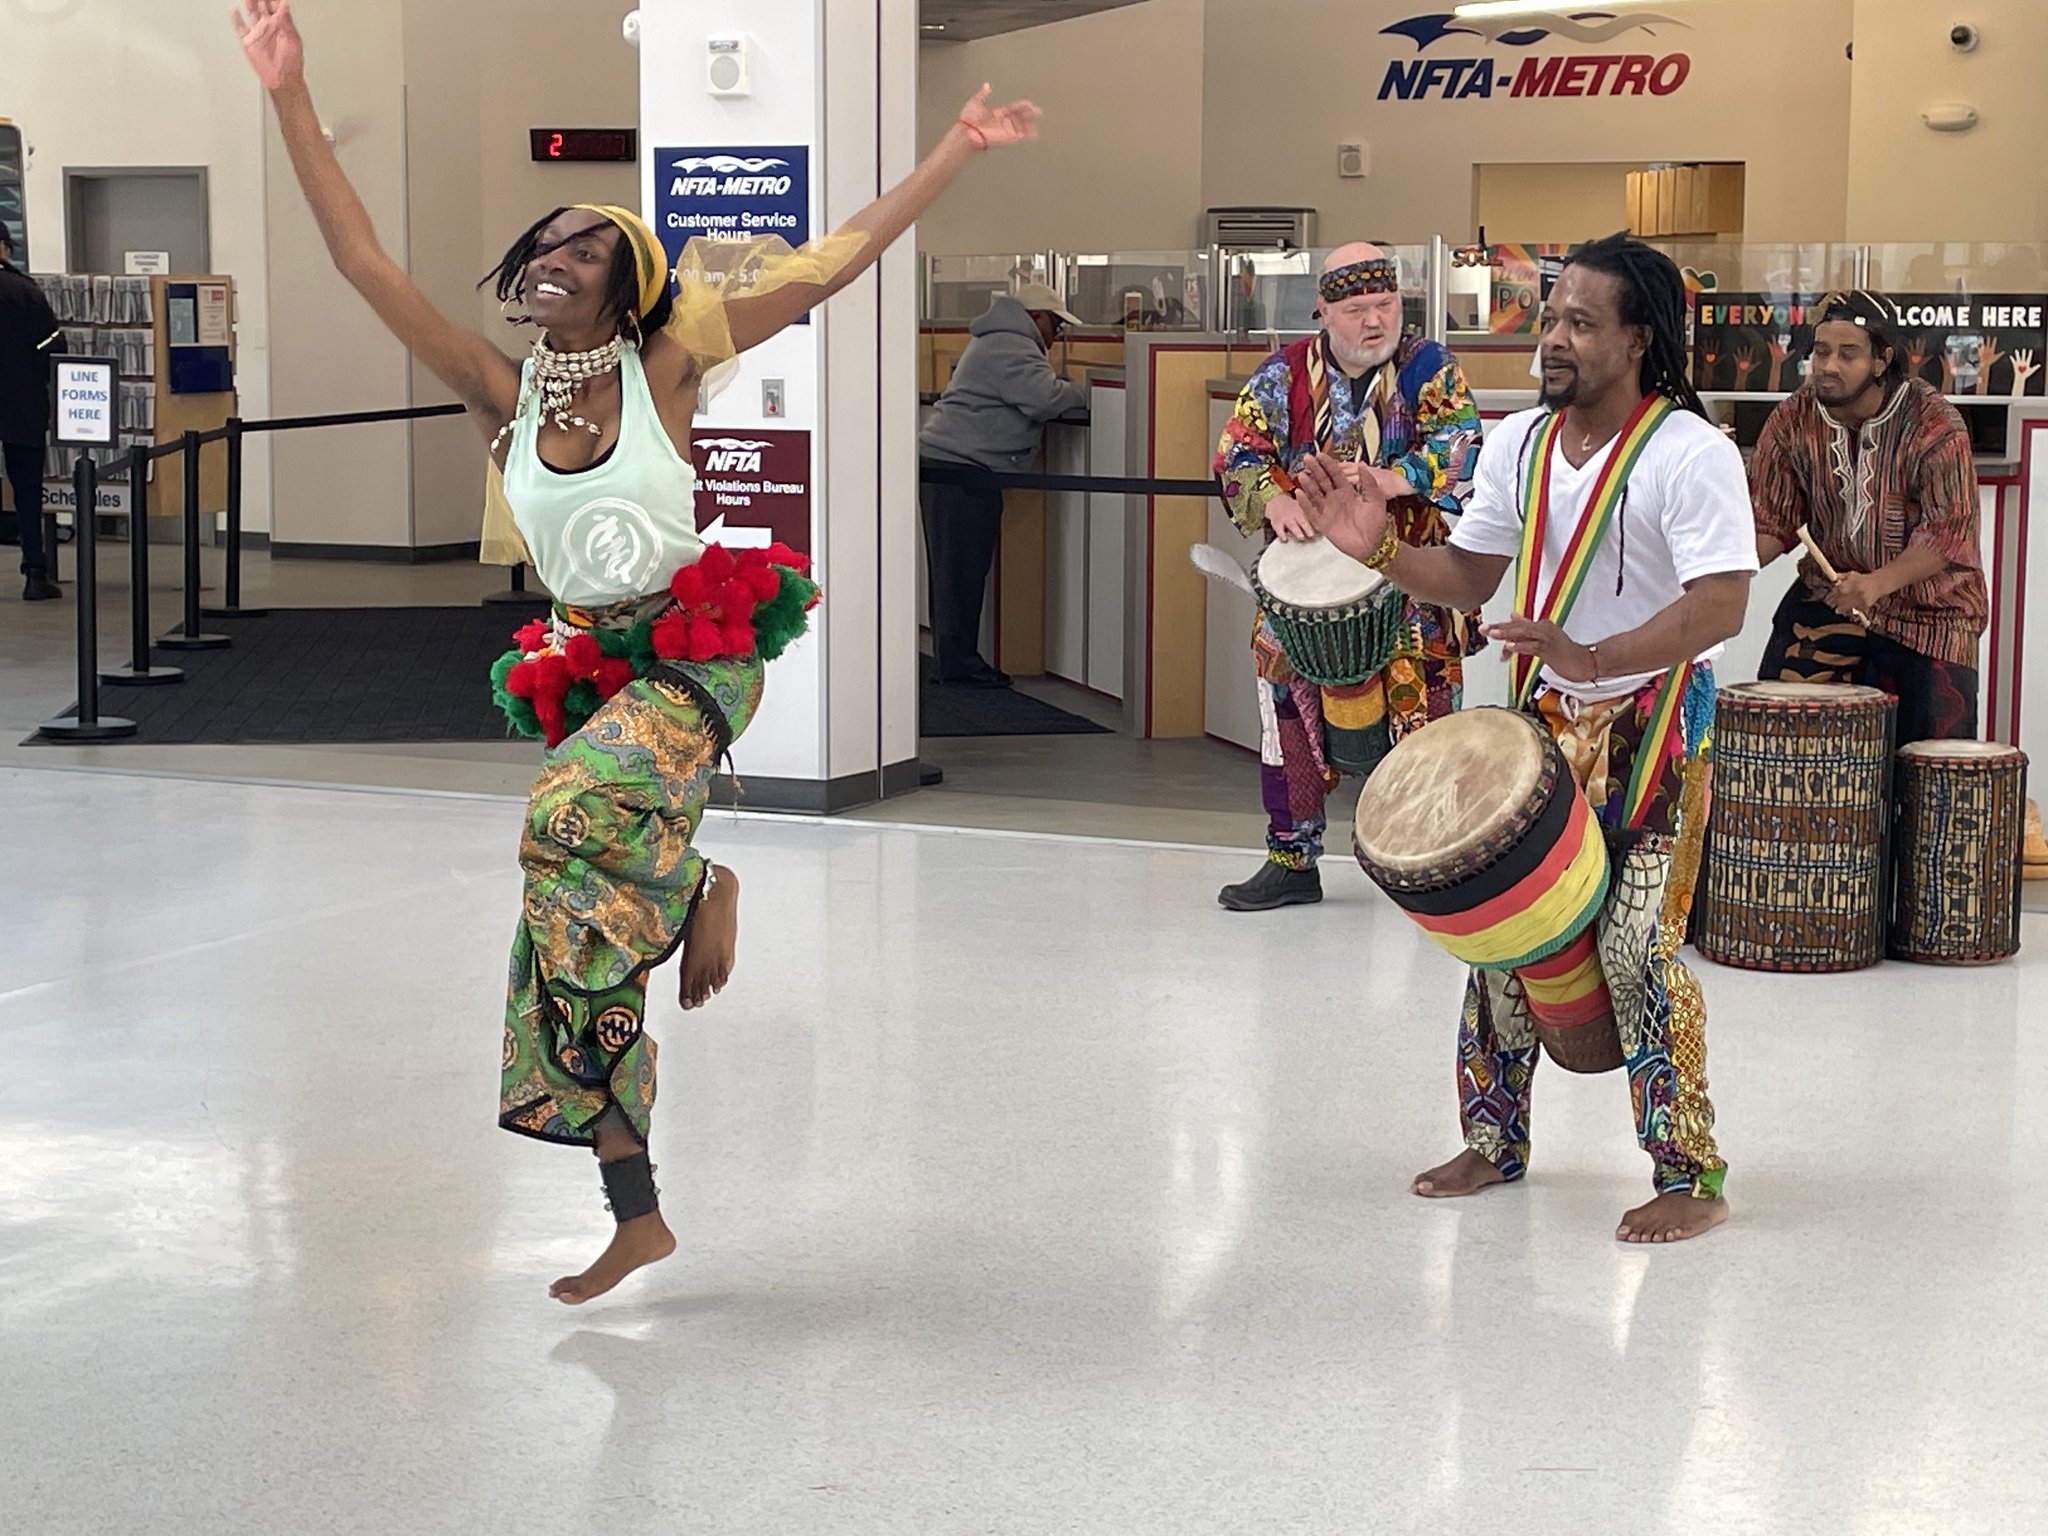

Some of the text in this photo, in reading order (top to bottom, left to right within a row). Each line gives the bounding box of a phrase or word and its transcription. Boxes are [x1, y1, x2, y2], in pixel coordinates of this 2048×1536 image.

[1377, 53, 1691, 100] NFTA-METRO
[549, 133, 563, 157] 2
[670, 175, 792, 196] NFTA-METRO
[667, 212, 797, 228] Customer Service
[706, 228, 751, 242] Hours
[1895, 305, 1970, 327] LCOME
[1982, 305, 2042, 328] HERE
[71, 370, 98, 382] LINE
[62, 388, 108, 402] FORMS
[68, 408, 101, 420] HERE
[705, 450, 761, 473] NFTA
[705, 478, 760, 492] Violations
[763, 481, 804, 494] Bureau
[41, 486, 121, 508] Scheles
[716, 493, 751, 506] Hours
